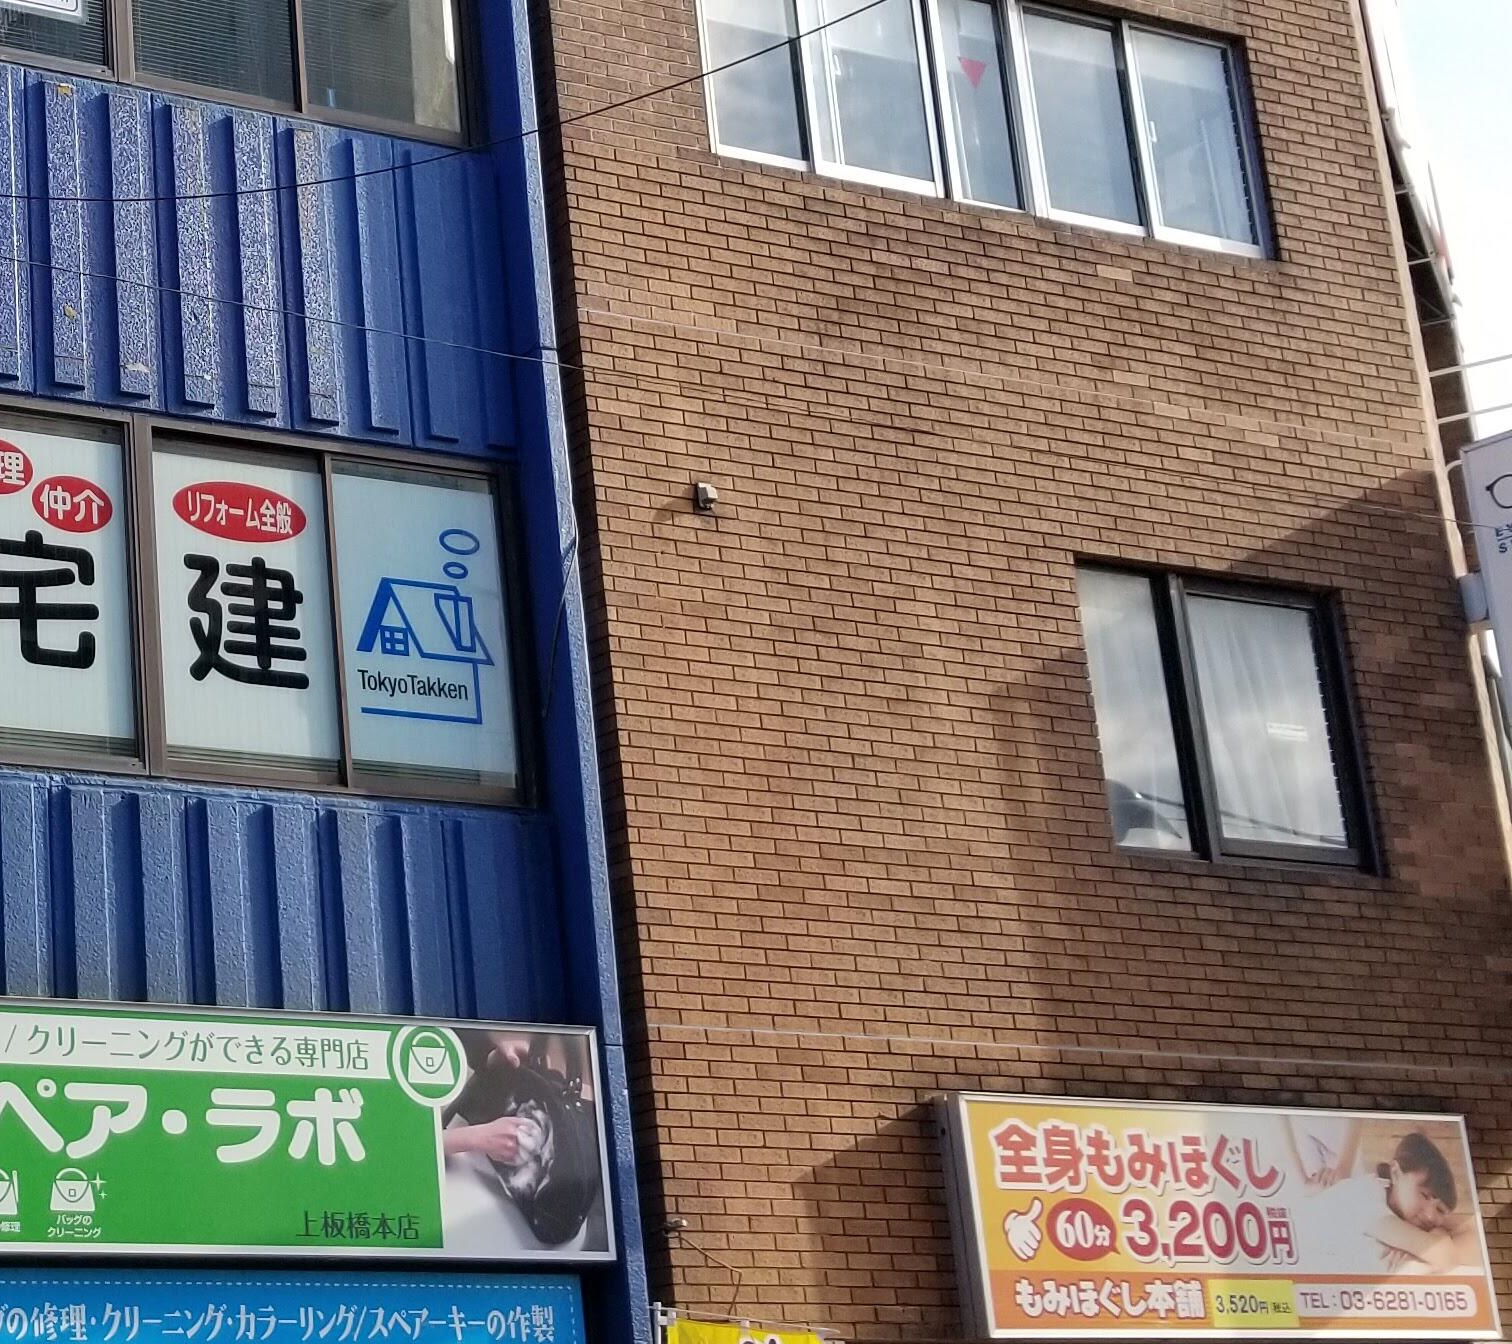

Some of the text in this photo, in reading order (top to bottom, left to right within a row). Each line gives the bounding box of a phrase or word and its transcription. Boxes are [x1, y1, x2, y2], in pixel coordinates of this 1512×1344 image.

[39, 484, 105, 524] 仲介
[187, 489, 293, 535] リフォーム全般
[357, 669, 469, 702] TokyoTakken
[990, 1120, 1282, 1193] 全身もみほぐし
[47, 1226, 102, 1239] クリーニング
[56, 1214, 92, 1226] バッグの
[296, 1209, 420, 1241] 上板橋本店
[1055, 1209, 1112, 1248] 60分
[1121, 1197, 1295, 1262] 3,200円
[1015, 1278, 1205, 1320] もみほぐし本舗
[1340, 1290, 1469, 1312] 03-6281-0165
